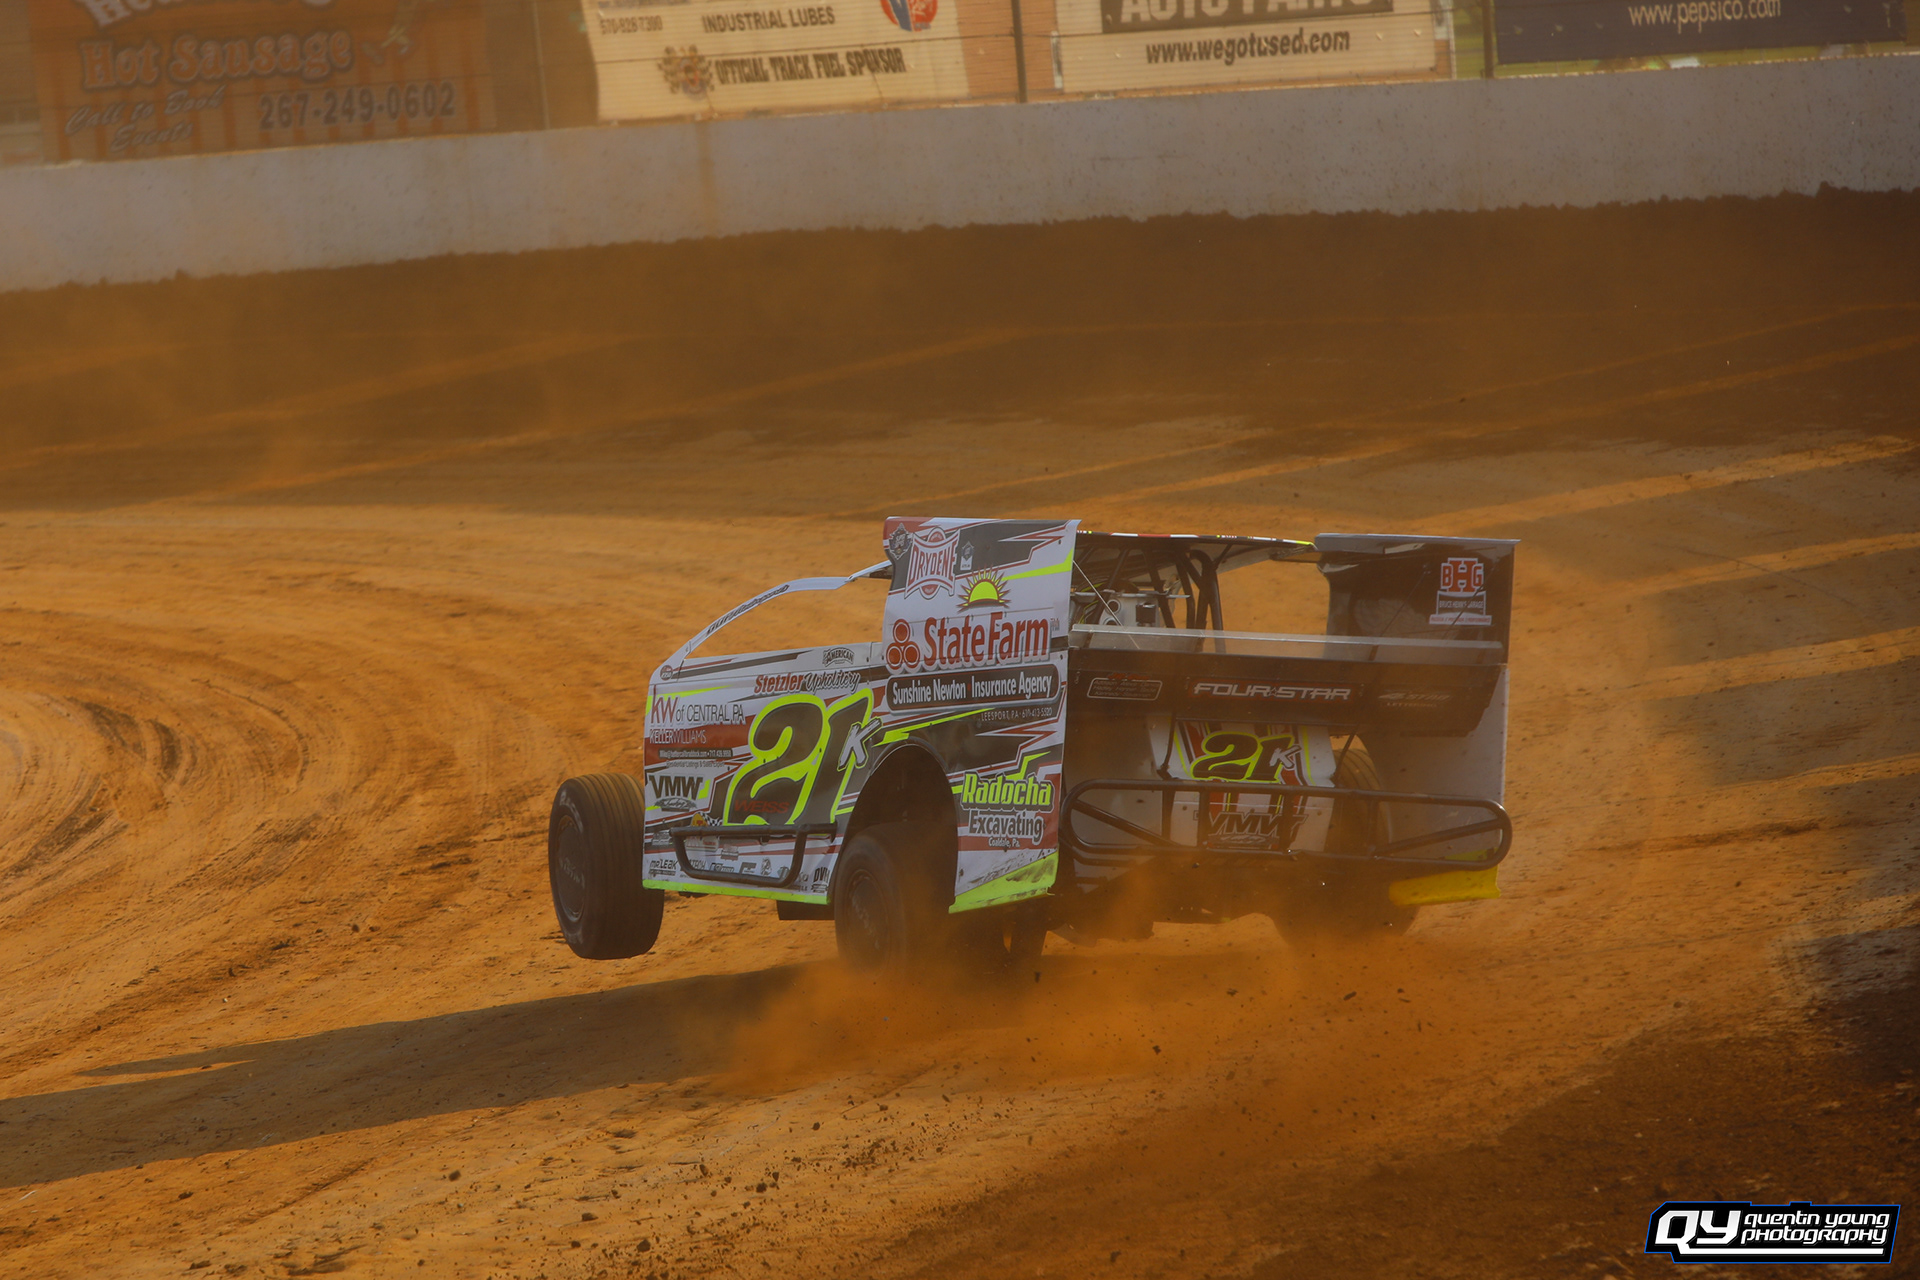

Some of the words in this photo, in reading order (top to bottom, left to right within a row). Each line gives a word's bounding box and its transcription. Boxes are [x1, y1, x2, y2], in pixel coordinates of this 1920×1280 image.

[703, 12, 788, 33] INDUSTRIAL
[790, 7, 836, 28] LUBES
[80, 39, 158, 89] Hot
[169, 29, 353, 81] Sausage
[1146, 28, 1350, 65] www.wegotused.com
[715, 57, 769, 85] OFFICIAL
[769, 54, 812, 83] TRACK
[813, 51, 846, 78] FUEL
[847, 48, 906, 76] SPONSOR
[65, 99, 124, 135] Call
[130, 99, 154, 124] to
[165, 84, 227, 115] Book
[259, 81, 456, 130] 267-249-0602
[110, 118, 193, 152] Events
[1441, 558, 1484, 592] BHG
[893, 678, 931, 705] Sunshine
[933, 677, 966, 700] Newton
[971, 675, 1015, 698] Insurance
[1018, 671, 1052, 699] Agency
[1194, 682, 1270, 698] FOUR
[1276, 686, 1352, 701] STAR
[676, 705, 685, 721] of
[687, 705, 730, 721] CENTRAL
[650, 775, 703, 800] VMW
[961, 774, 1051, 806] Radocha
[735, 801, 789, 816] WEISS
[969, 811, 1043, 844] Excavating
